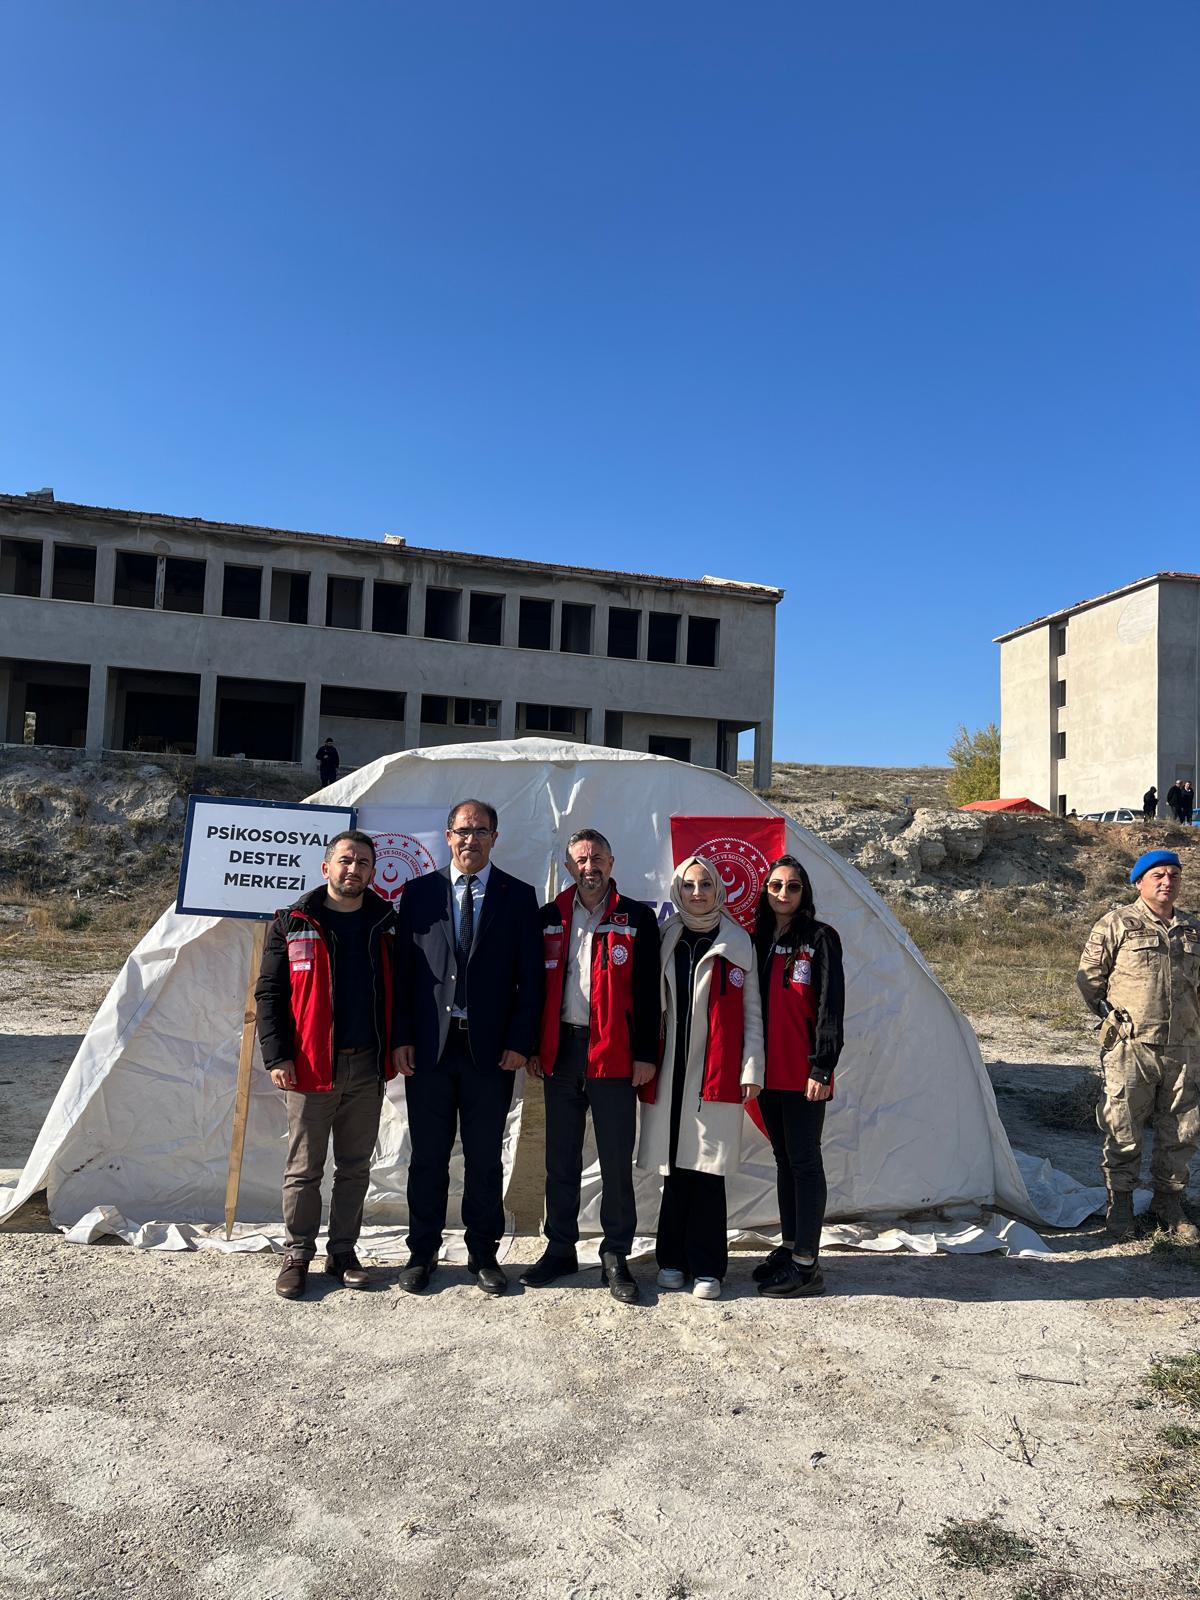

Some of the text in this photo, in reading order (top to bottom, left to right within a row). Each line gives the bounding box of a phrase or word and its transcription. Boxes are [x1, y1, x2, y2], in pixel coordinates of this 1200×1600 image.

[206, 824, 331, 847] PSİKOSOSYAL
[228, 849, 302, 868] DESTEK
[223, 872, 306, 891] MERKEZİ
